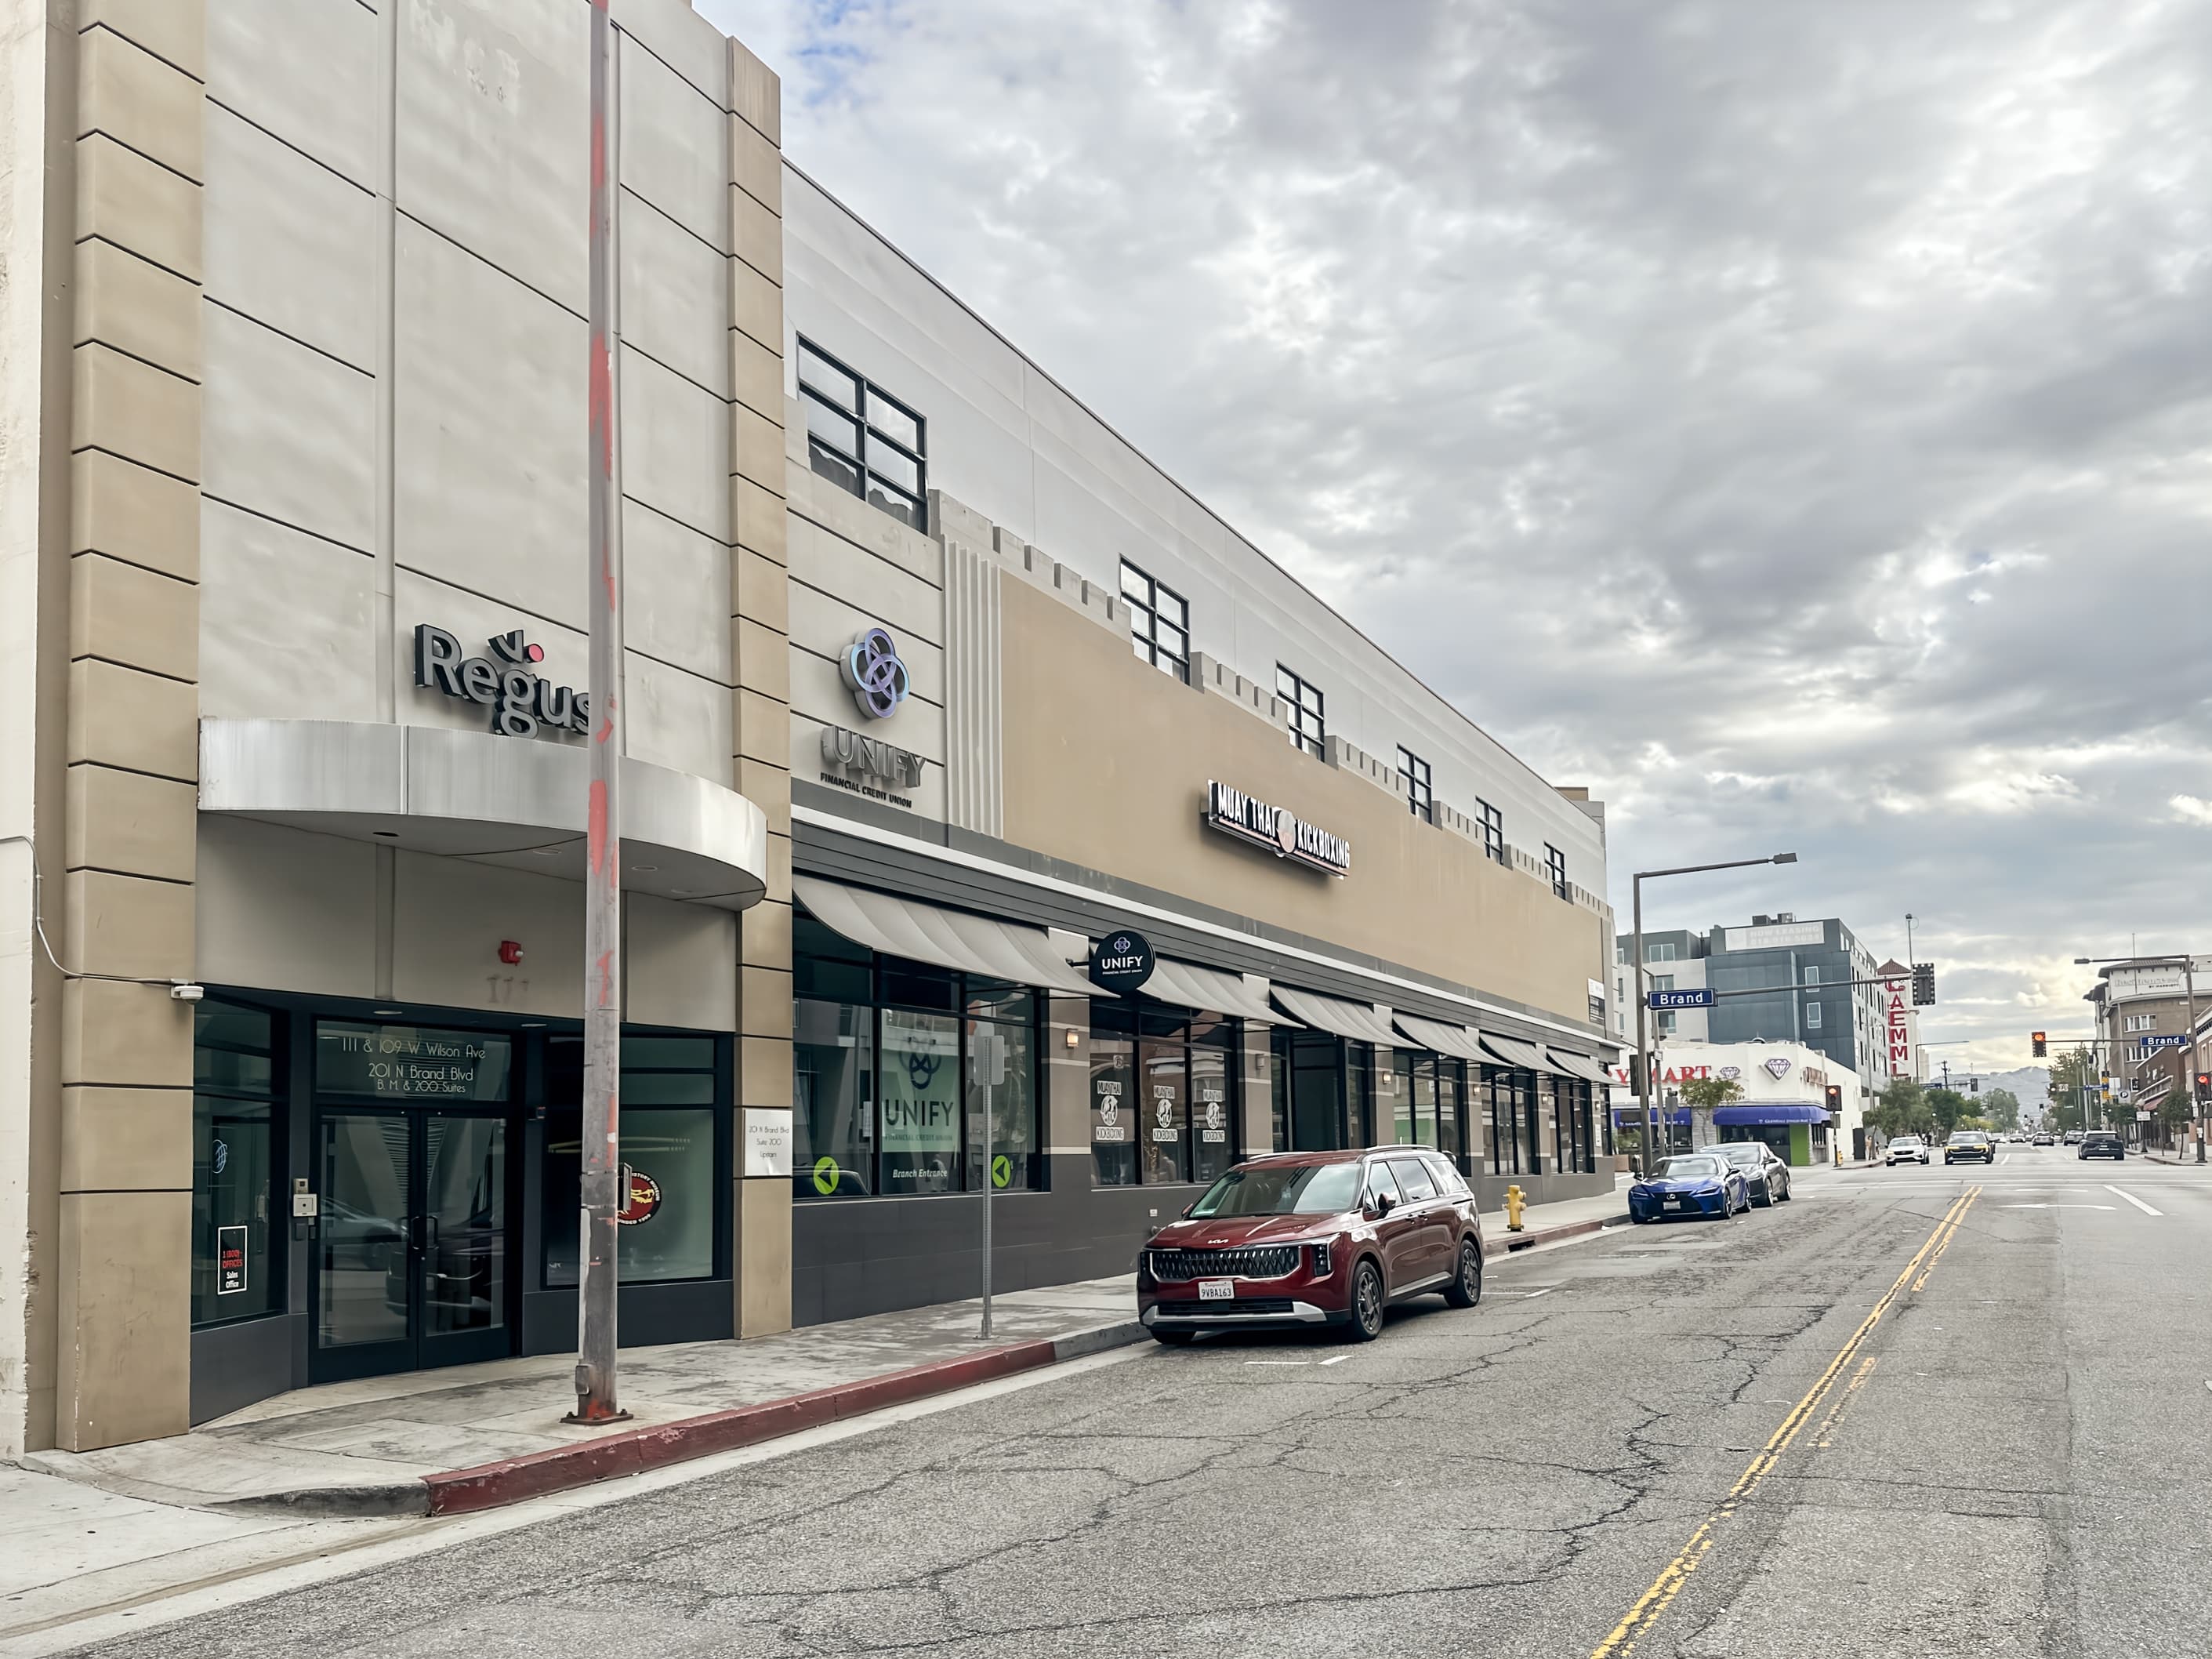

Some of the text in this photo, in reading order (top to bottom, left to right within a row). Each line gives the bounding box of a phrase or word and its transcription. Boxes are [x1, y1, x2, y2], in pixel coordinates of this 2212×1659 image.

[415, 624, 589, 739] Regus
[821, 725, 927, 788] UNIFY
[820, 772, 912, 808] FINANCIAL CREDIT UNION
[1217, 782, 1351, 869] MUAY THAI KICKBOXING
[1101, 955, 1144, 969] UNIFY
[1659, 992, 1703, 1005] Brand
[343, 1036, 486, 1058] 111 & 109 W Wilson Ave
[2147, 1036, 2180, 1045] Brand
[368, 1062, 473, 1081] 201 N Brand Blvd
[403, 1081, 411, 1091] &
[415, 1081, 439, 1092] 200
[442, 1082, 466, 1093] Suites
[885, 1098, 954, 1127] UNIFY
[892, 1168, 948, 1178] Branch Entrance
[1201, 1288, 1231, 1298] 9VBA163
